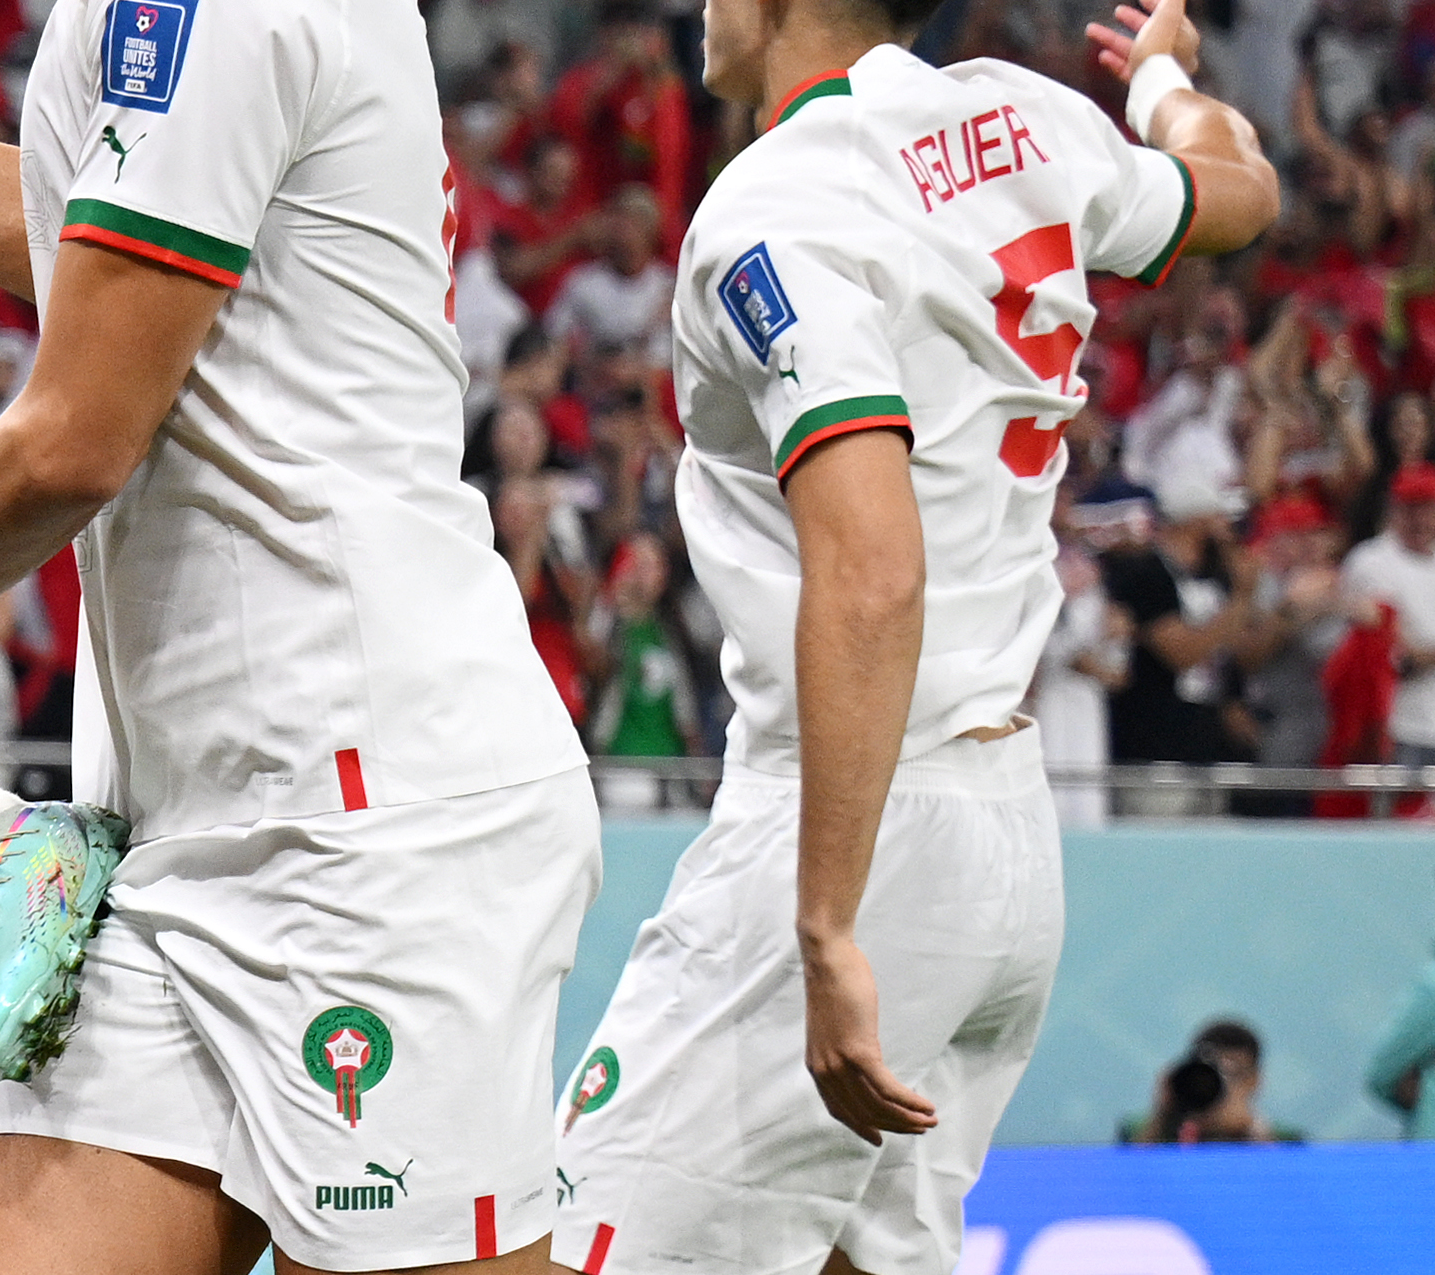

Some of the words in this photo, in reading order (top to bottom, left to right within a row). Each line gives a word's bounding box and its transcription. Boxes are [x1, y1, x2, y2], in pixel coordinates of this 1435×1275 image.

[123, 48, 157, 67] UNITES
[125, 37, 157, 53] FOOTBALL
[899, 105, 1050, 213] AGUER
[991, 223, 1088, 478] 5
[316, 1185, 394, 1210] PUMA
